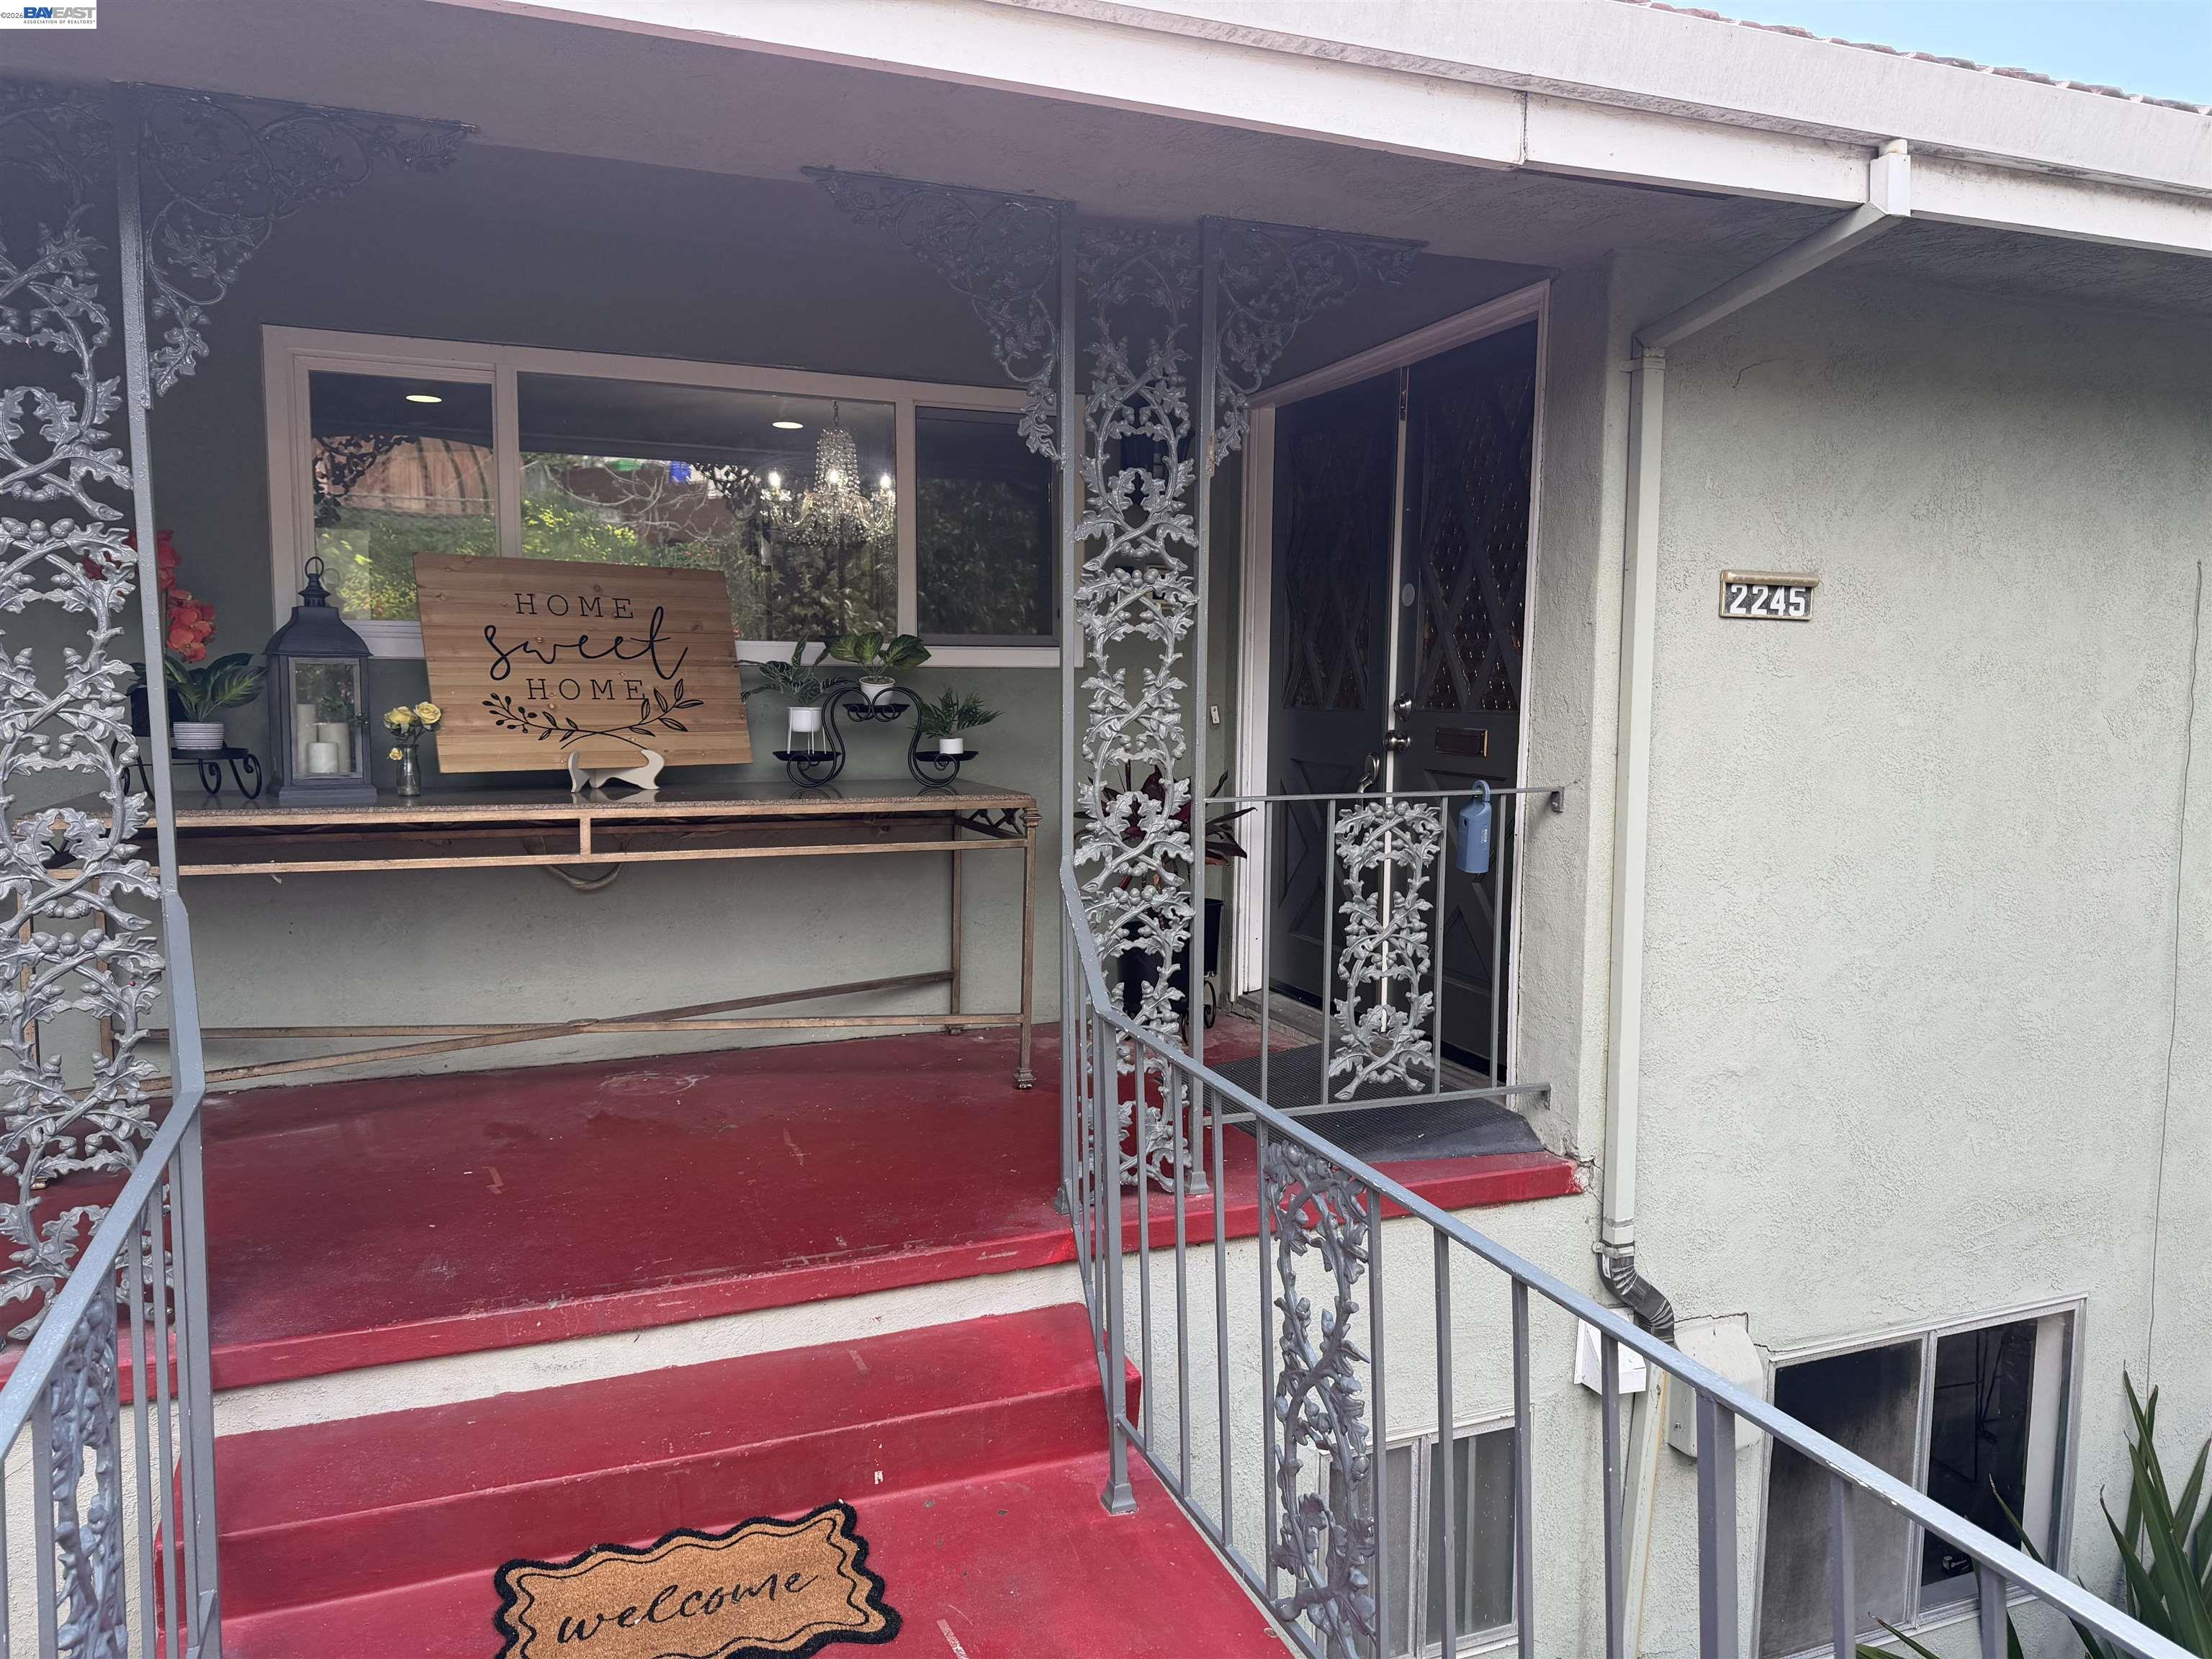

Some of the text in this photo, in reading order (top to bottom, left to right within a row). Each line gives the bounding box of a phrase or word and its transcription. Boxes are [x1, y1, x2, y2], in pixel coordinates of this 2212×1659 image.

[514, 593, 634, 619] HOME
[1730, 583, 1806, 616] 2245
[484, 606, 688, 680] sweet
[526, 678, 647, 701] HOME
[557, 1572, 819, 1643] welcome
